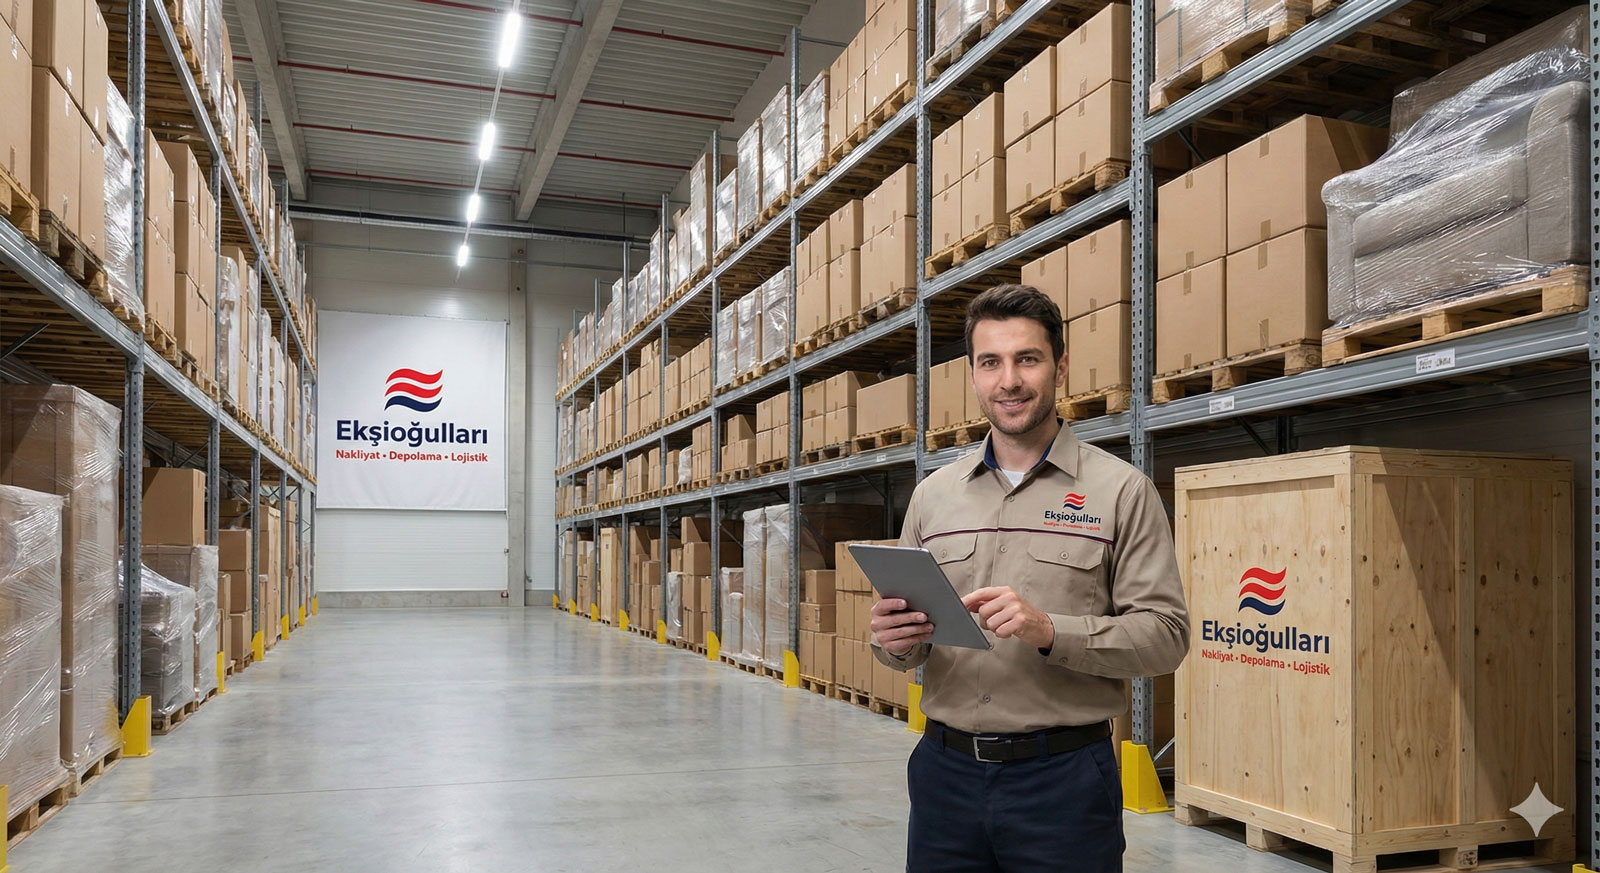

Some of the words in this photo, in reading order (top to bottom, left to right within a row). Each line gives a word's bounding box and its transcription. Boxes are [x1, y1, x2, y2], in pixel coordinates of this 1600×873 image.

[336, 420, 488, 447] Ekşioğulları
[336, 450, 380, 461] Nakliyat
[389, 451, 442, 462] Depolama
[451, 453, 488, 464] Lojistik
[1044, 510, 1101, 524] Ekşioğulları
[1202, 620, 1330, 654] Ekşioğulları
[1202, 649, 1234, 663] Nakliyat
[1240, 654, 1285, 669] Depolama
[1293, 661, 1331, 676] Lojistik
